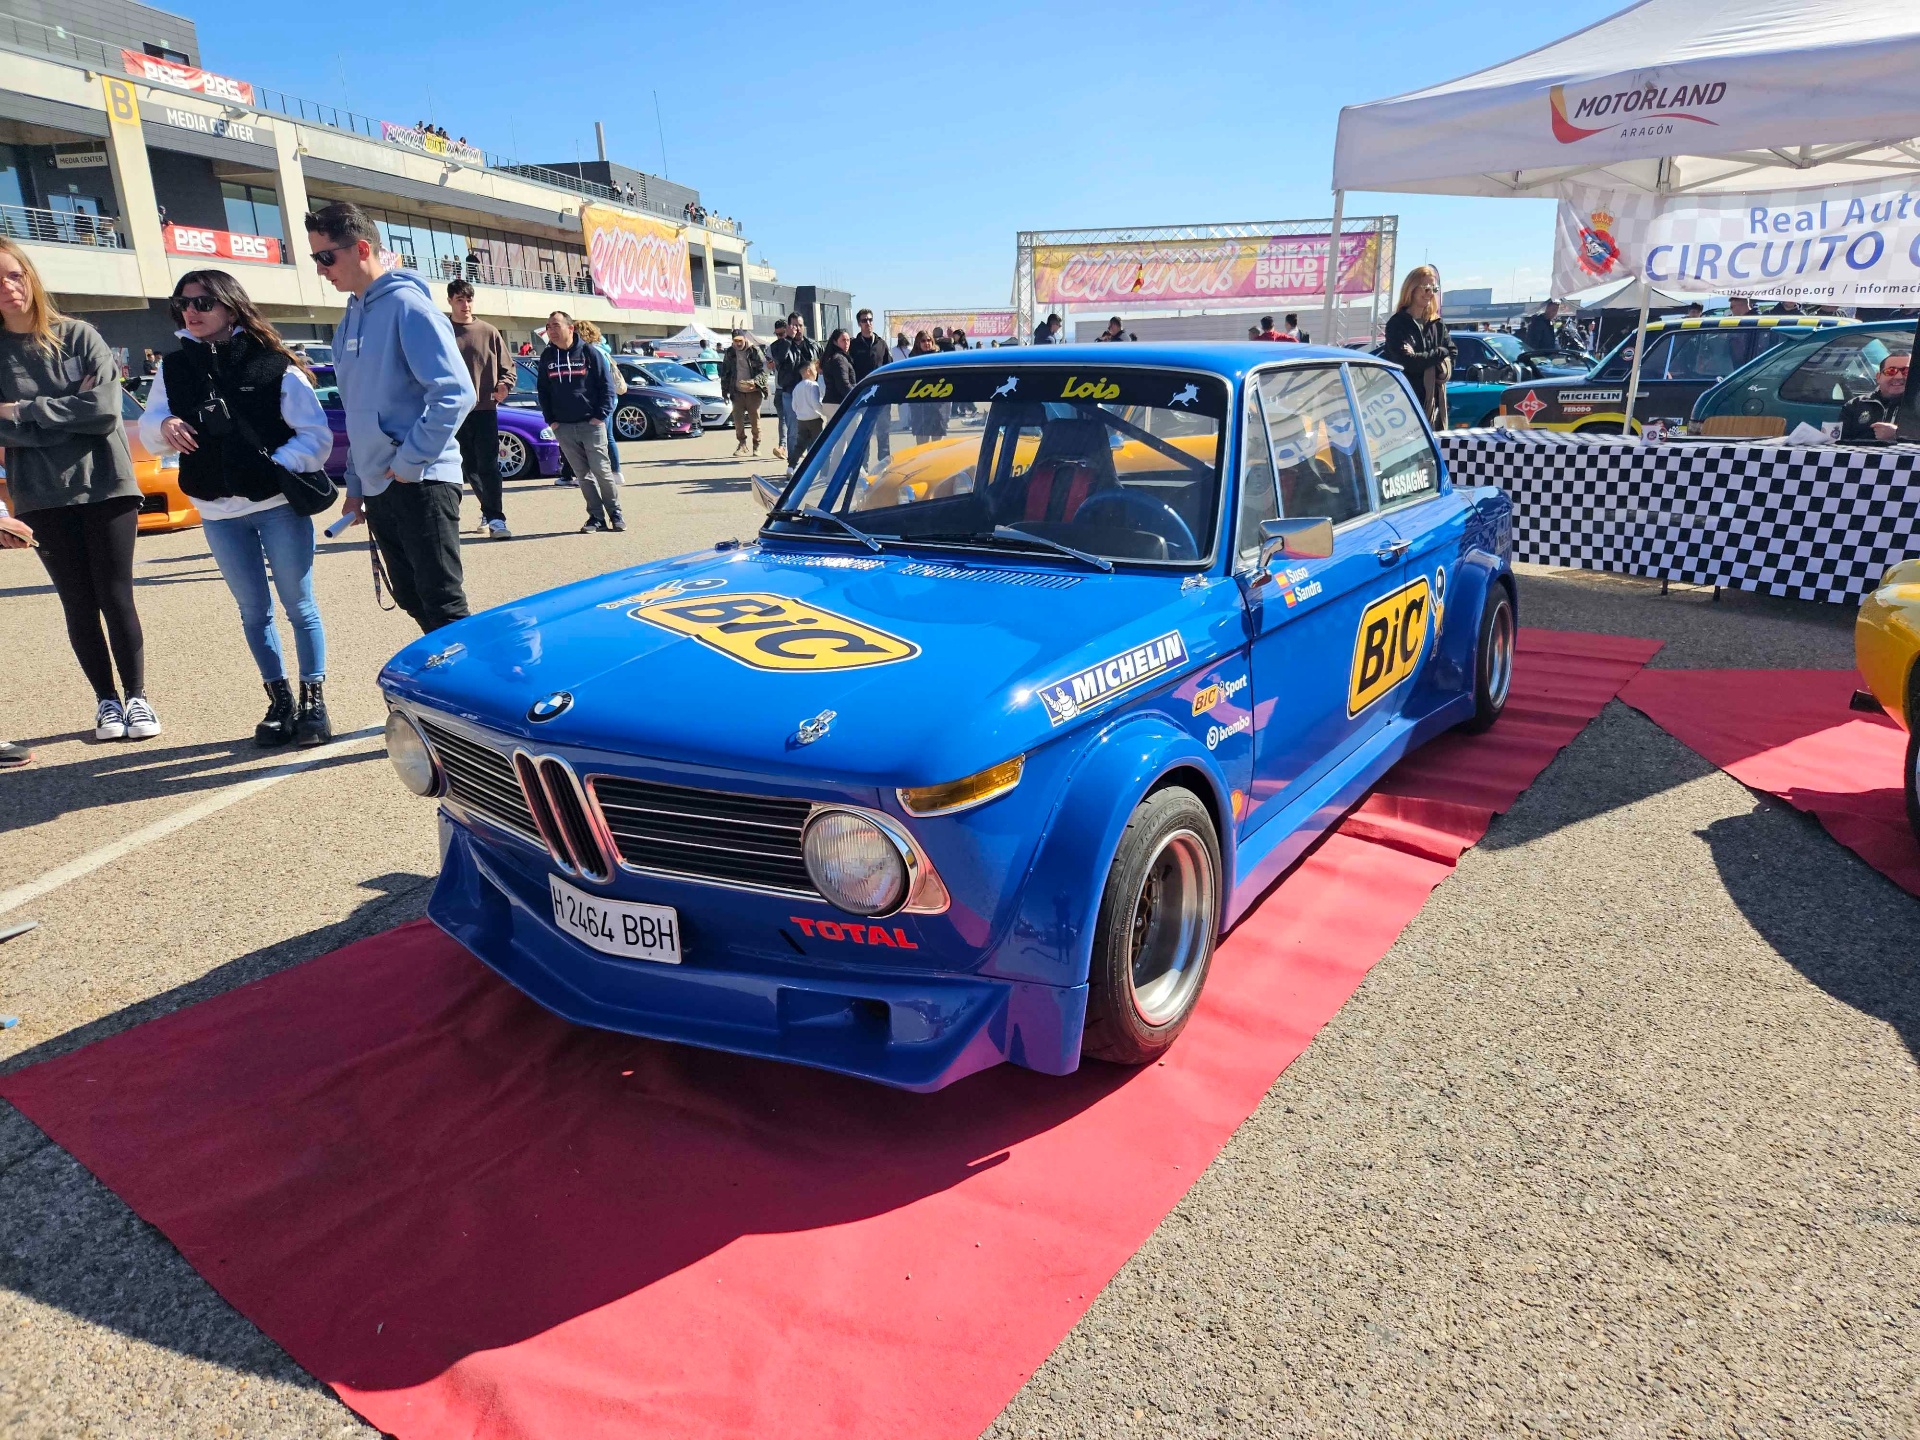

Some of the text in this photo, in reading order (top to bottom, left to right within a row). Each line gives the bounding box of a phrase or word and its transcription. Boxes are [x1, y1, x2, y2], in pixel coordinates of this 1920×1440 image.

[109, 81, 133, 120] B
[1574, 82, 1727, 119] MOTORLAND
[166, 108, 254, 143] MEDIA CENTER
[1620, 124, 1673, 138] ARAGÓN
[60, 155, 104, 165] MEDIA CENTER
[1750, 200, 1828, 234] Real
[1257, 242, 1331, 259] DREAM
[1646, 231, 1885, 281] CIRCUITO
[1256, 258, 1318, 274] BUILD
[1254, 273, 1318, 289] DRIVE
[905, 378, 954, 399] Lois
[1060, 376, 1121, 399] Lois
[1560, 392, 1621, 401] MICHELIN
[1522, 402, 1539, 411] CS
[1382, 469, 1430, 500] CASSAGNE
[1285, 567, 1309, 584] Suso
[1294, 580, 1323, 602] Sandra
[1071, 633, 1183, 704] MICHELIN
[1225, 674, 1248, 699] Sport
[1219, 715, 1250, 742] brembo
[552, 884, 676, 952] H 2464 BBH
[789, 916, 919, 949] TOTAL
